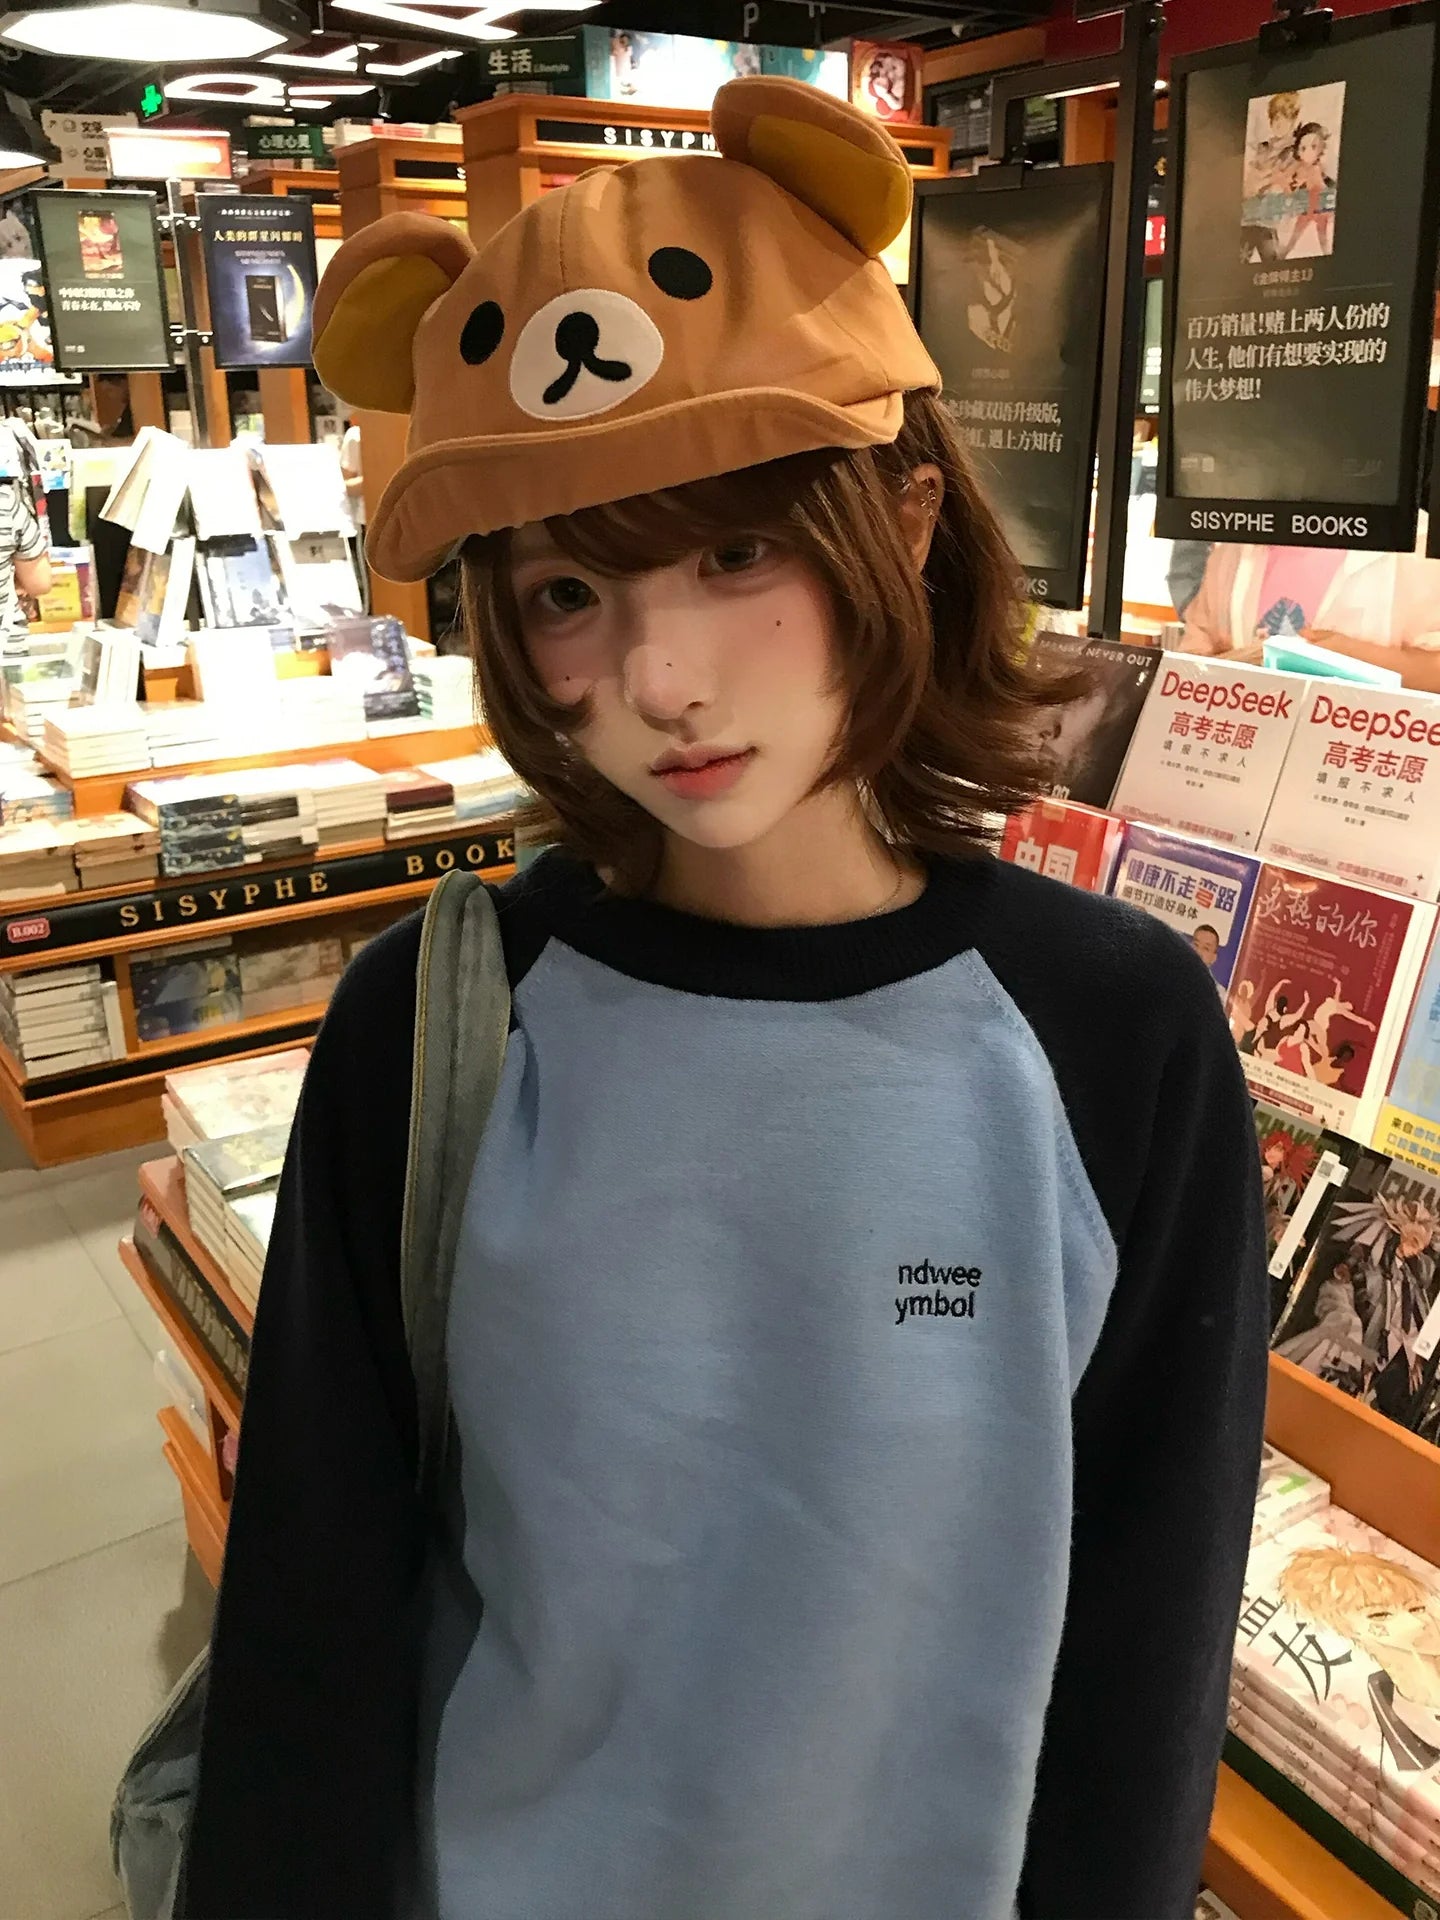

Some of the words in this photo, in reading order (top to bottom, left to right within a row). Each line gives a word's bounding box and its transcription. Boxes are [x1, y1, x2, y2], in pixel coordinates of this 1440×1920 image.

[487, 47, 533, 76] 生活
[1187, 301, 1391, 340] 百万销量!赌上两人份的
[1184, 376, 1263, 402] 伟大梦想!
[1189, 510, 1275, 533] SISYPHE
[1291, 514, 1368, 538] BOOKS
[1126, 654, 1153, 668] OUT
[1160, 670, 1293, 720] DeepSeek
[1168, 710, 1259, 750] 高考志愿
[1163, 739, 1247, 769] 填报不求人
[1322, 740, 1428, 785] 高考志愿
[1316, 771, 1416, 805] 填报不求人
[120, 871, 329, 928] SISYPHE
[1122, 883, 1199, 920] 细节打造好身体
[1127, 856, 1238, 913] 健康不走弯路
[898, 1258, 982, 1287] ndwee
[894, 1288, 975, 1325] ymbol
